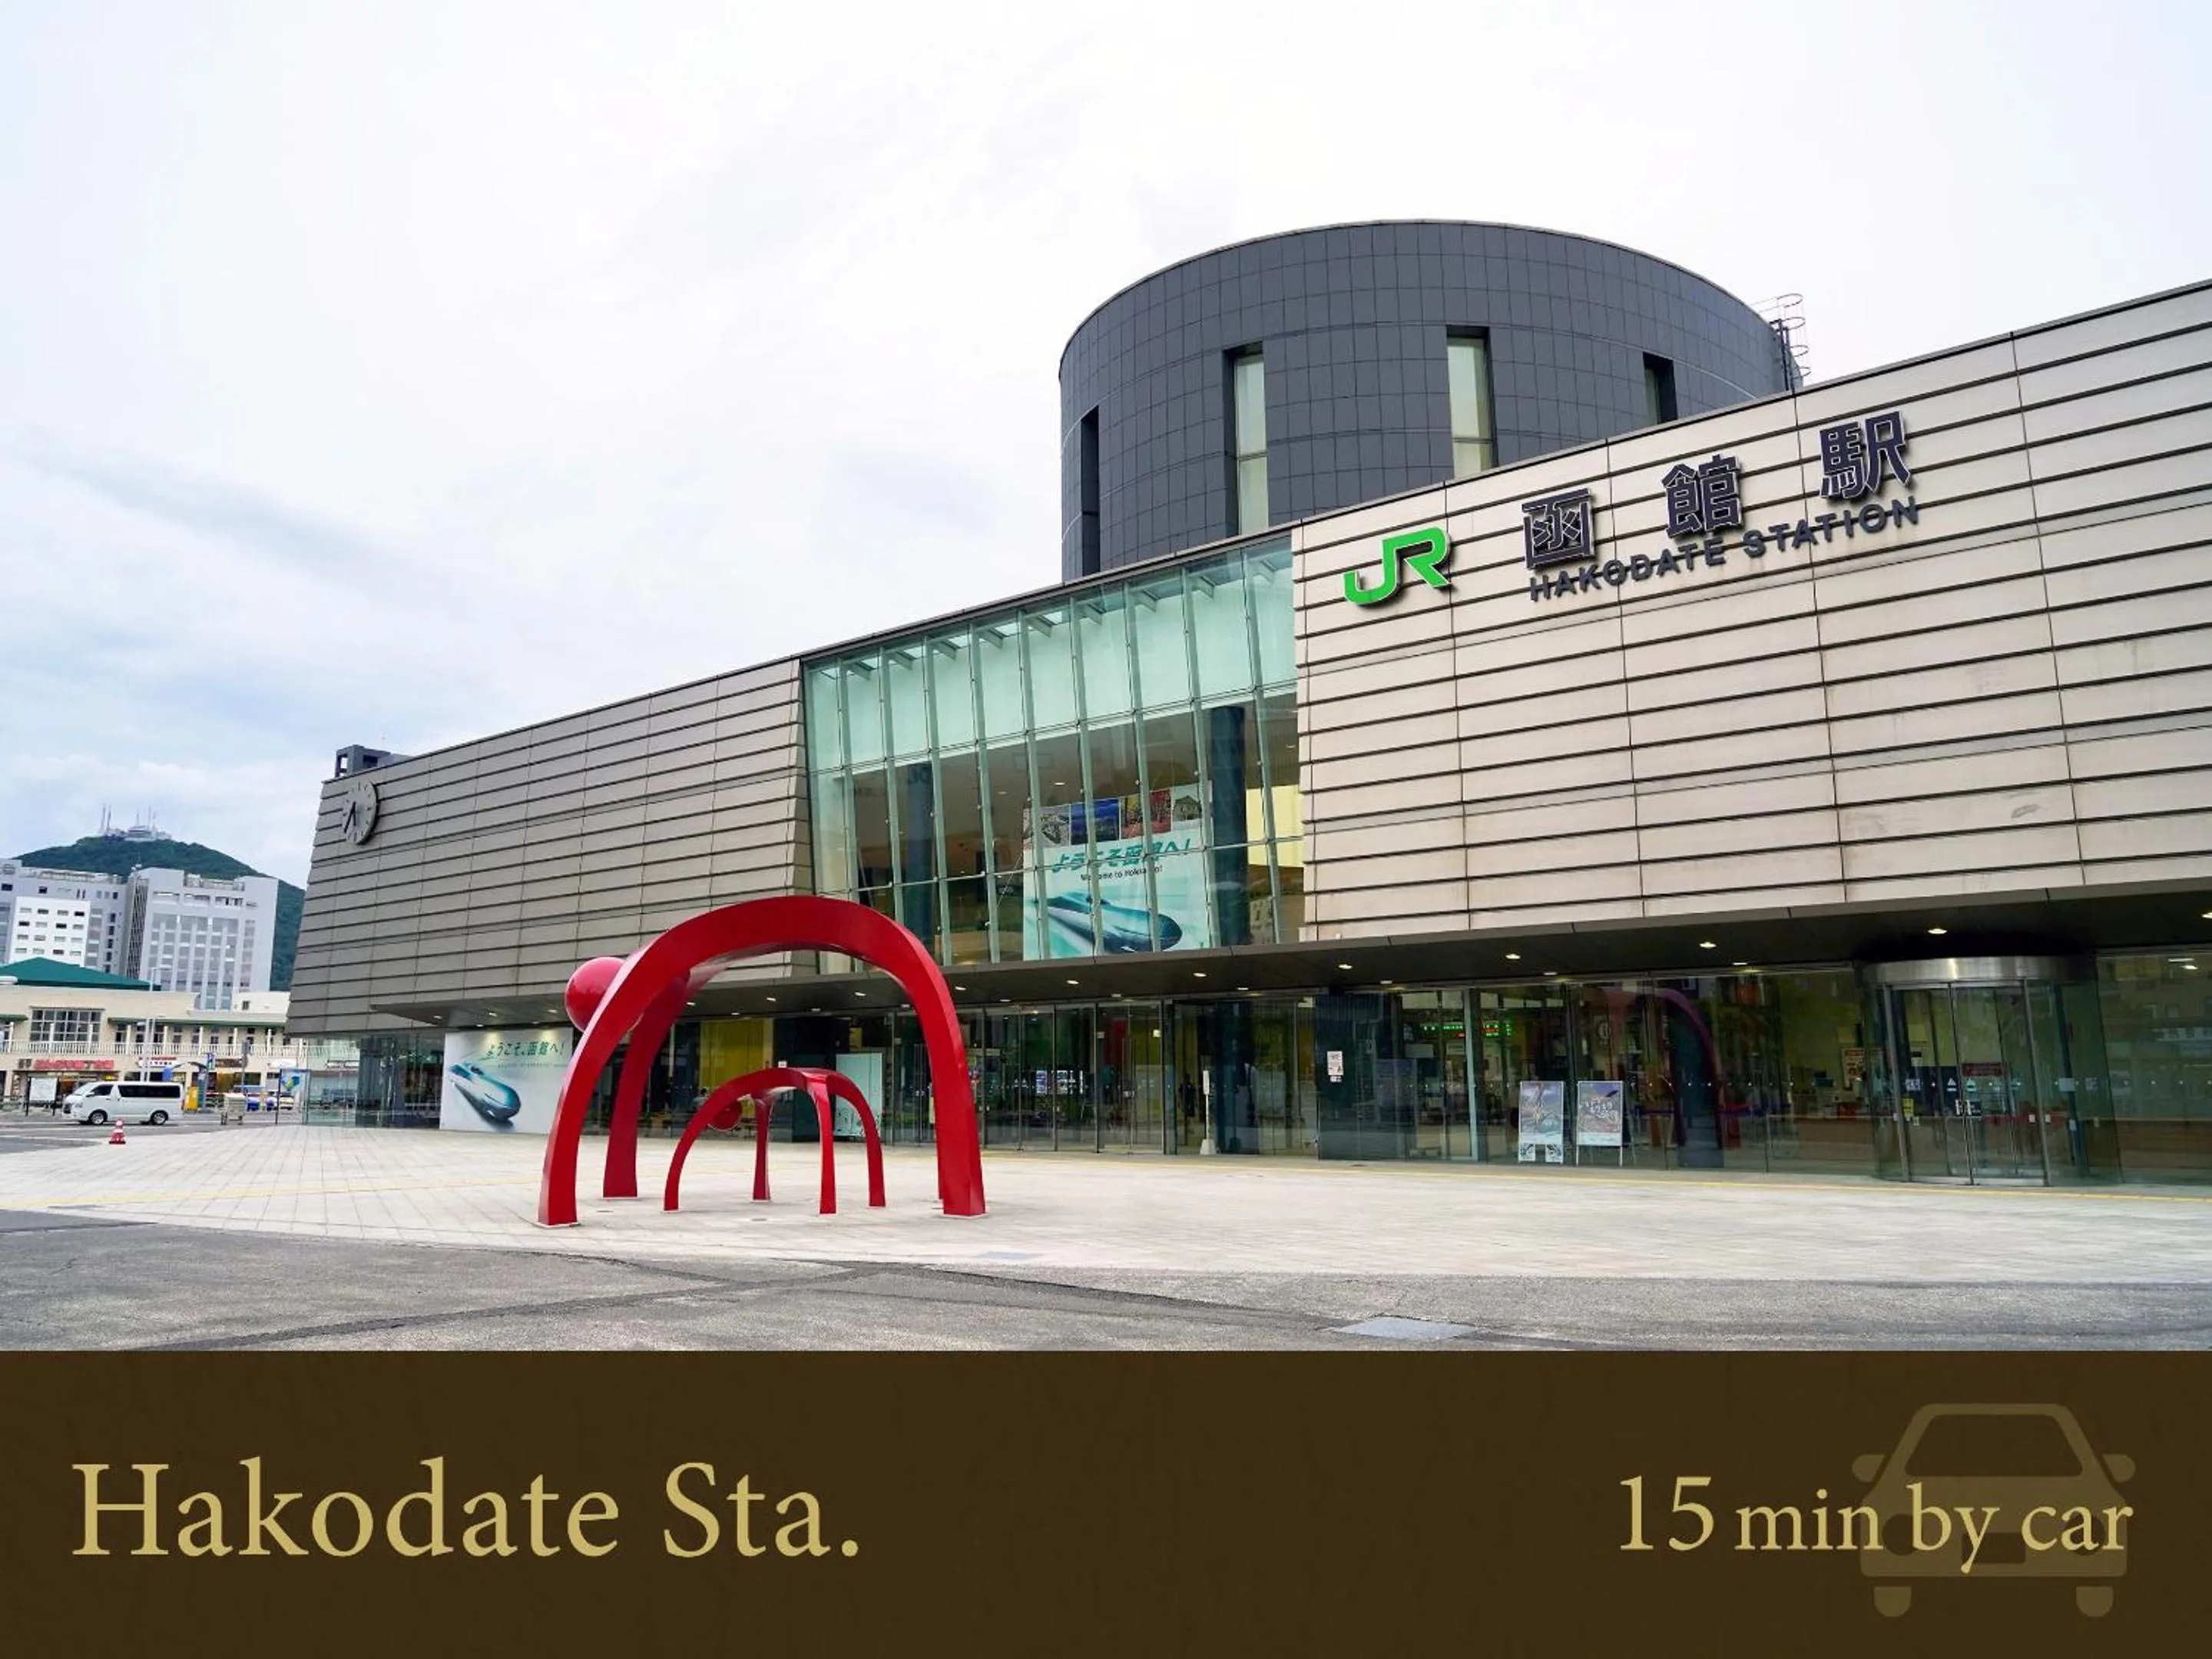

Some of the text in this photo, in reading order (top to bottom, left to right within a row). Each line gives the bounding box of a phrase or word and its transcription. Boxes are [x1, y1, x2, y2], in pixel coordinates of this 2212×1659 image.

[1522, 411, 1910, 569] 函館駅
[1344, 527, 1450, 604] JR
[1530, 495, 1919, 602] HAKODATE STATION
[1081, 871, 1113, 882] Wome
[1124, 864, 1163, 877] Hokkao!
